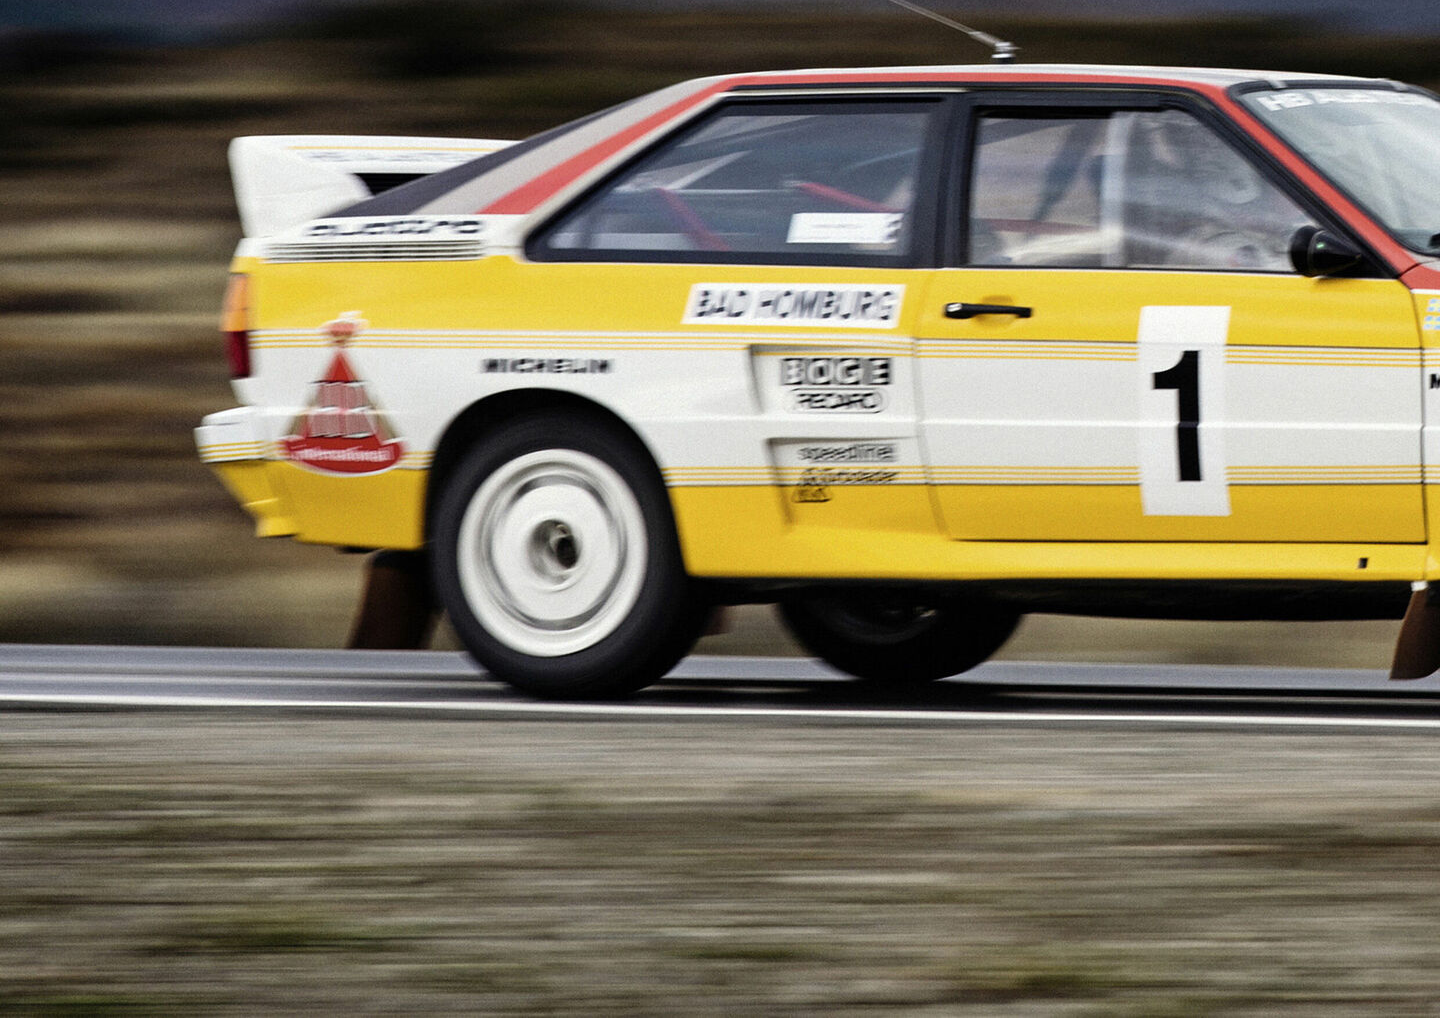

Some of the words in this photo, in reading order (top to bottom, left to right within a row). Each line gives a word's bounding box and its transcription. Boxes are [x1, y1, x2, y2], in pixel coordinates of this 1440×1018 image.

[695, 289, 747, 319] BAD
[756, 290, 894, 322] HOMBURG
[480, 358, 613, 374] MICHELIN
[1150, 349, 1203, 482] 1
